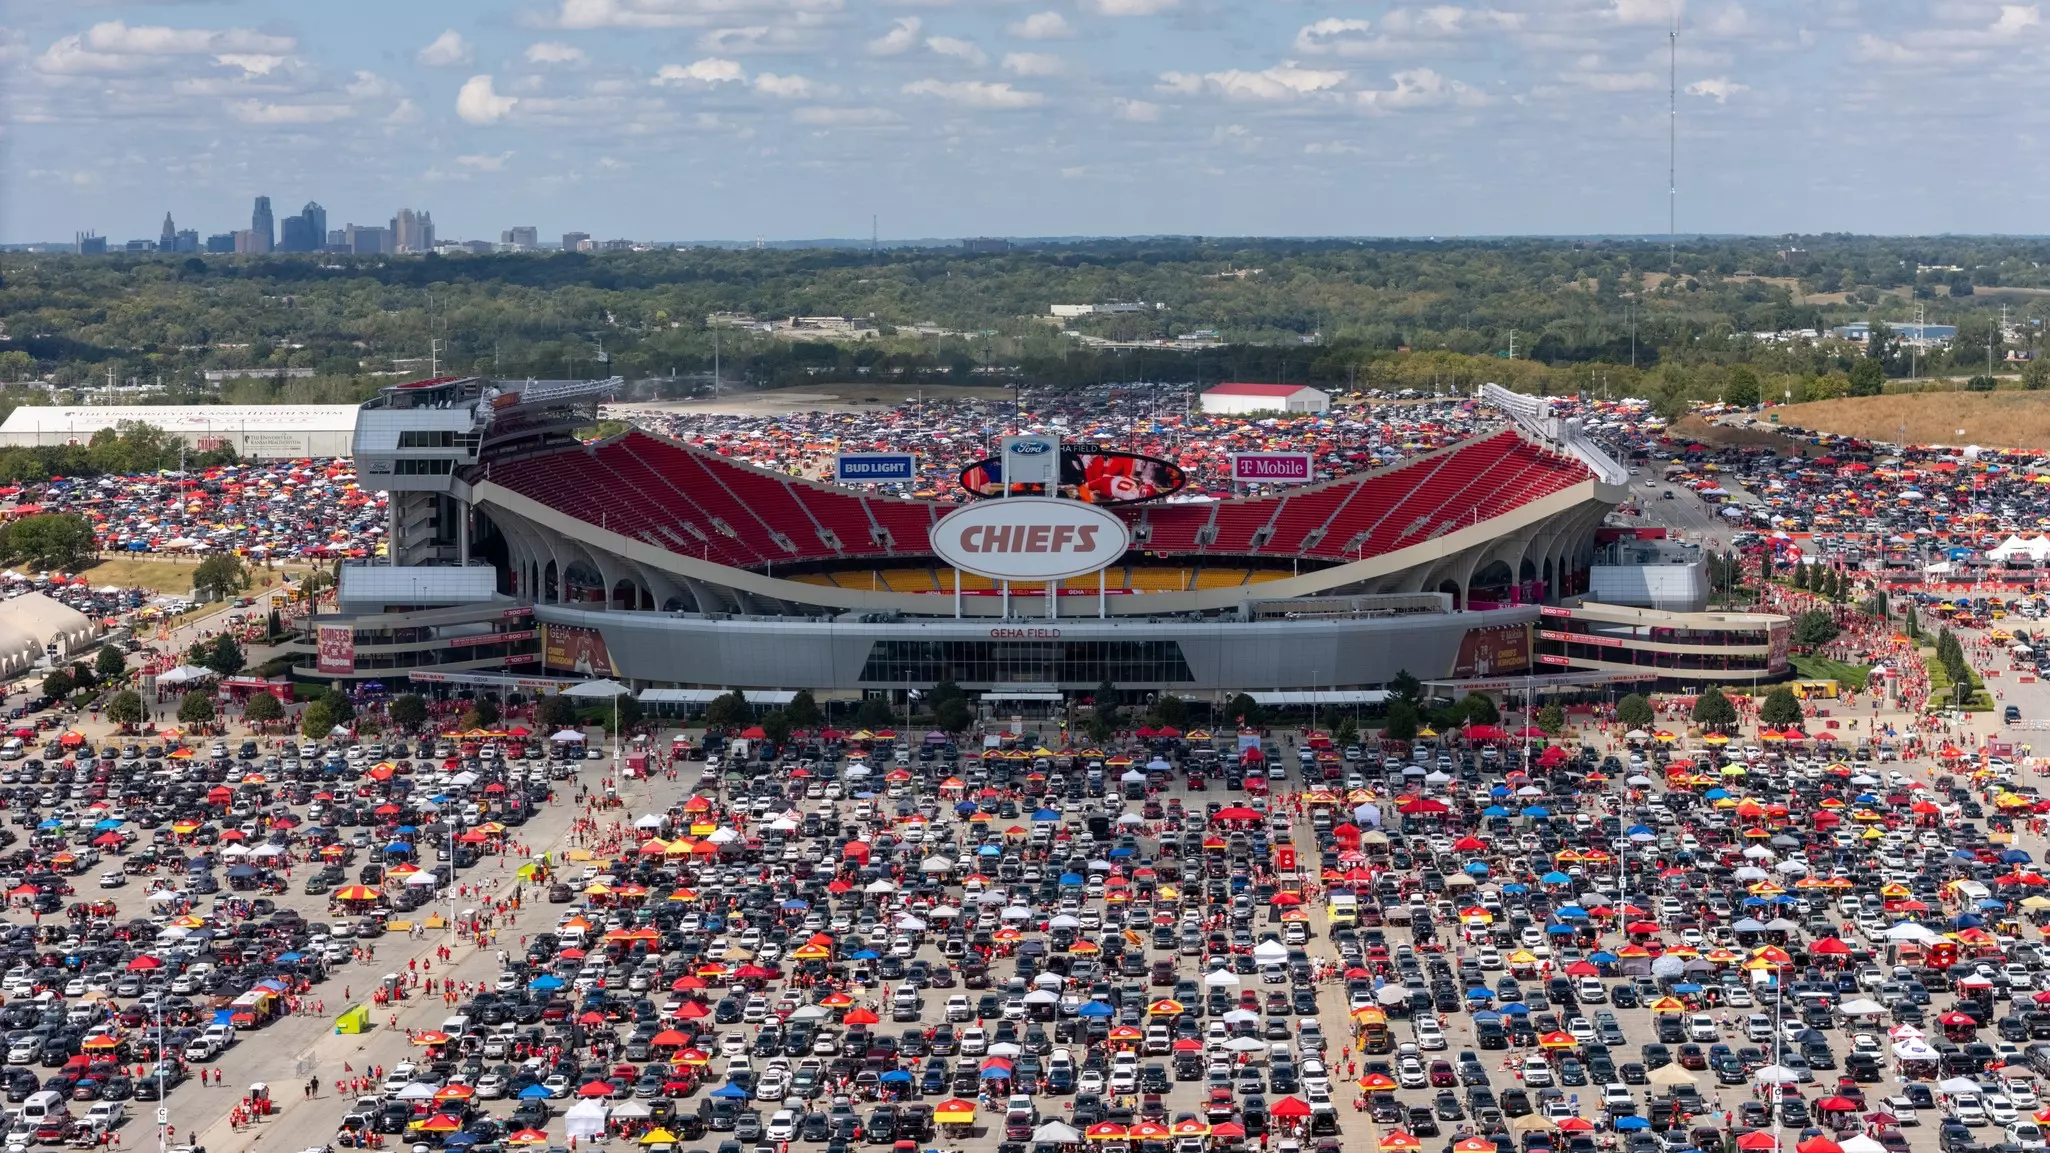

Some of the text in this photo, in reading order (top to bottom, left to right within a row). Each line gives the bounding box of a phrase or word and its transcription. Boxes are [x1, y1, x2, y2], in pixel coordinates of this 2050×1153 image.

[1018, 442, 1042, 453] Ford
[845, 463, 905, 473] BUD LIGHT
[1256, 461, 1303, 474] Mobile
[960, 525, 1099, 552] CHIEFS
[321, 628, 350, 642] CHIEFS
[550, 629, 571, 640] GEHA
[991, 629, 1060, 638] GEHA FIELD
